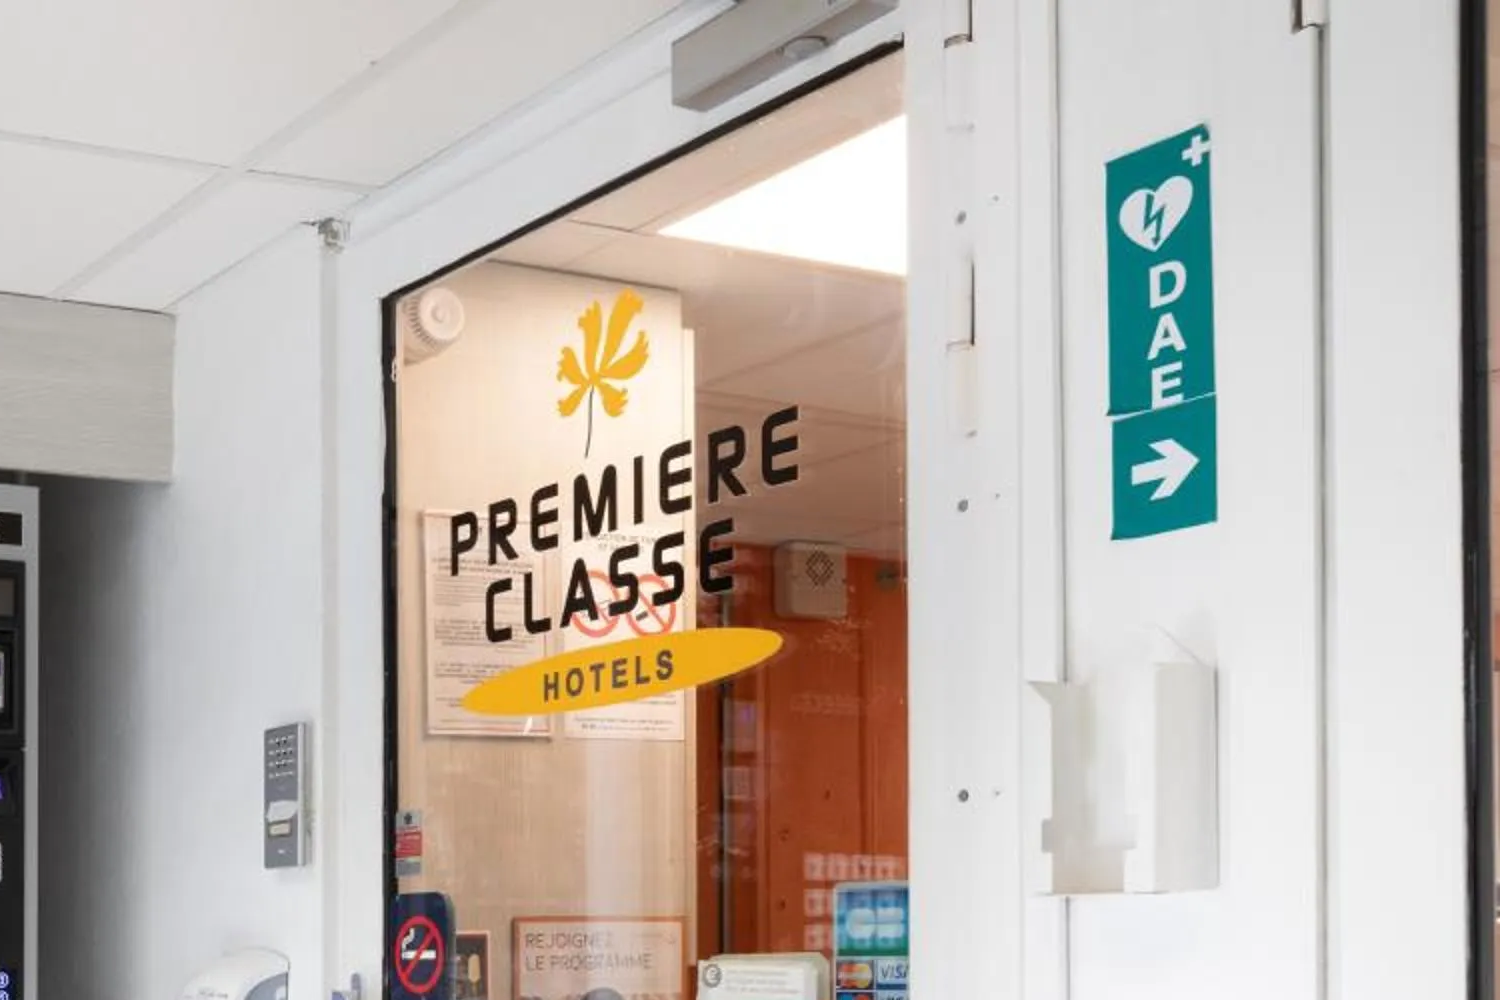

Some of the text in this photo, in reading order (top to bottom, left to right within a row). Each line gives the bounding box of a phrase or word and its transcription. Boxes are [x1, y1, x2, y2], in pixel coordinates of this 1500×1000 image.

[1147, 260, 1187, 411] DAE
[450, 405, 799, 577] PREMIERE
[484, 518, 735, 644] CLASSE
[542, 649, 675, 703] HOTELS
